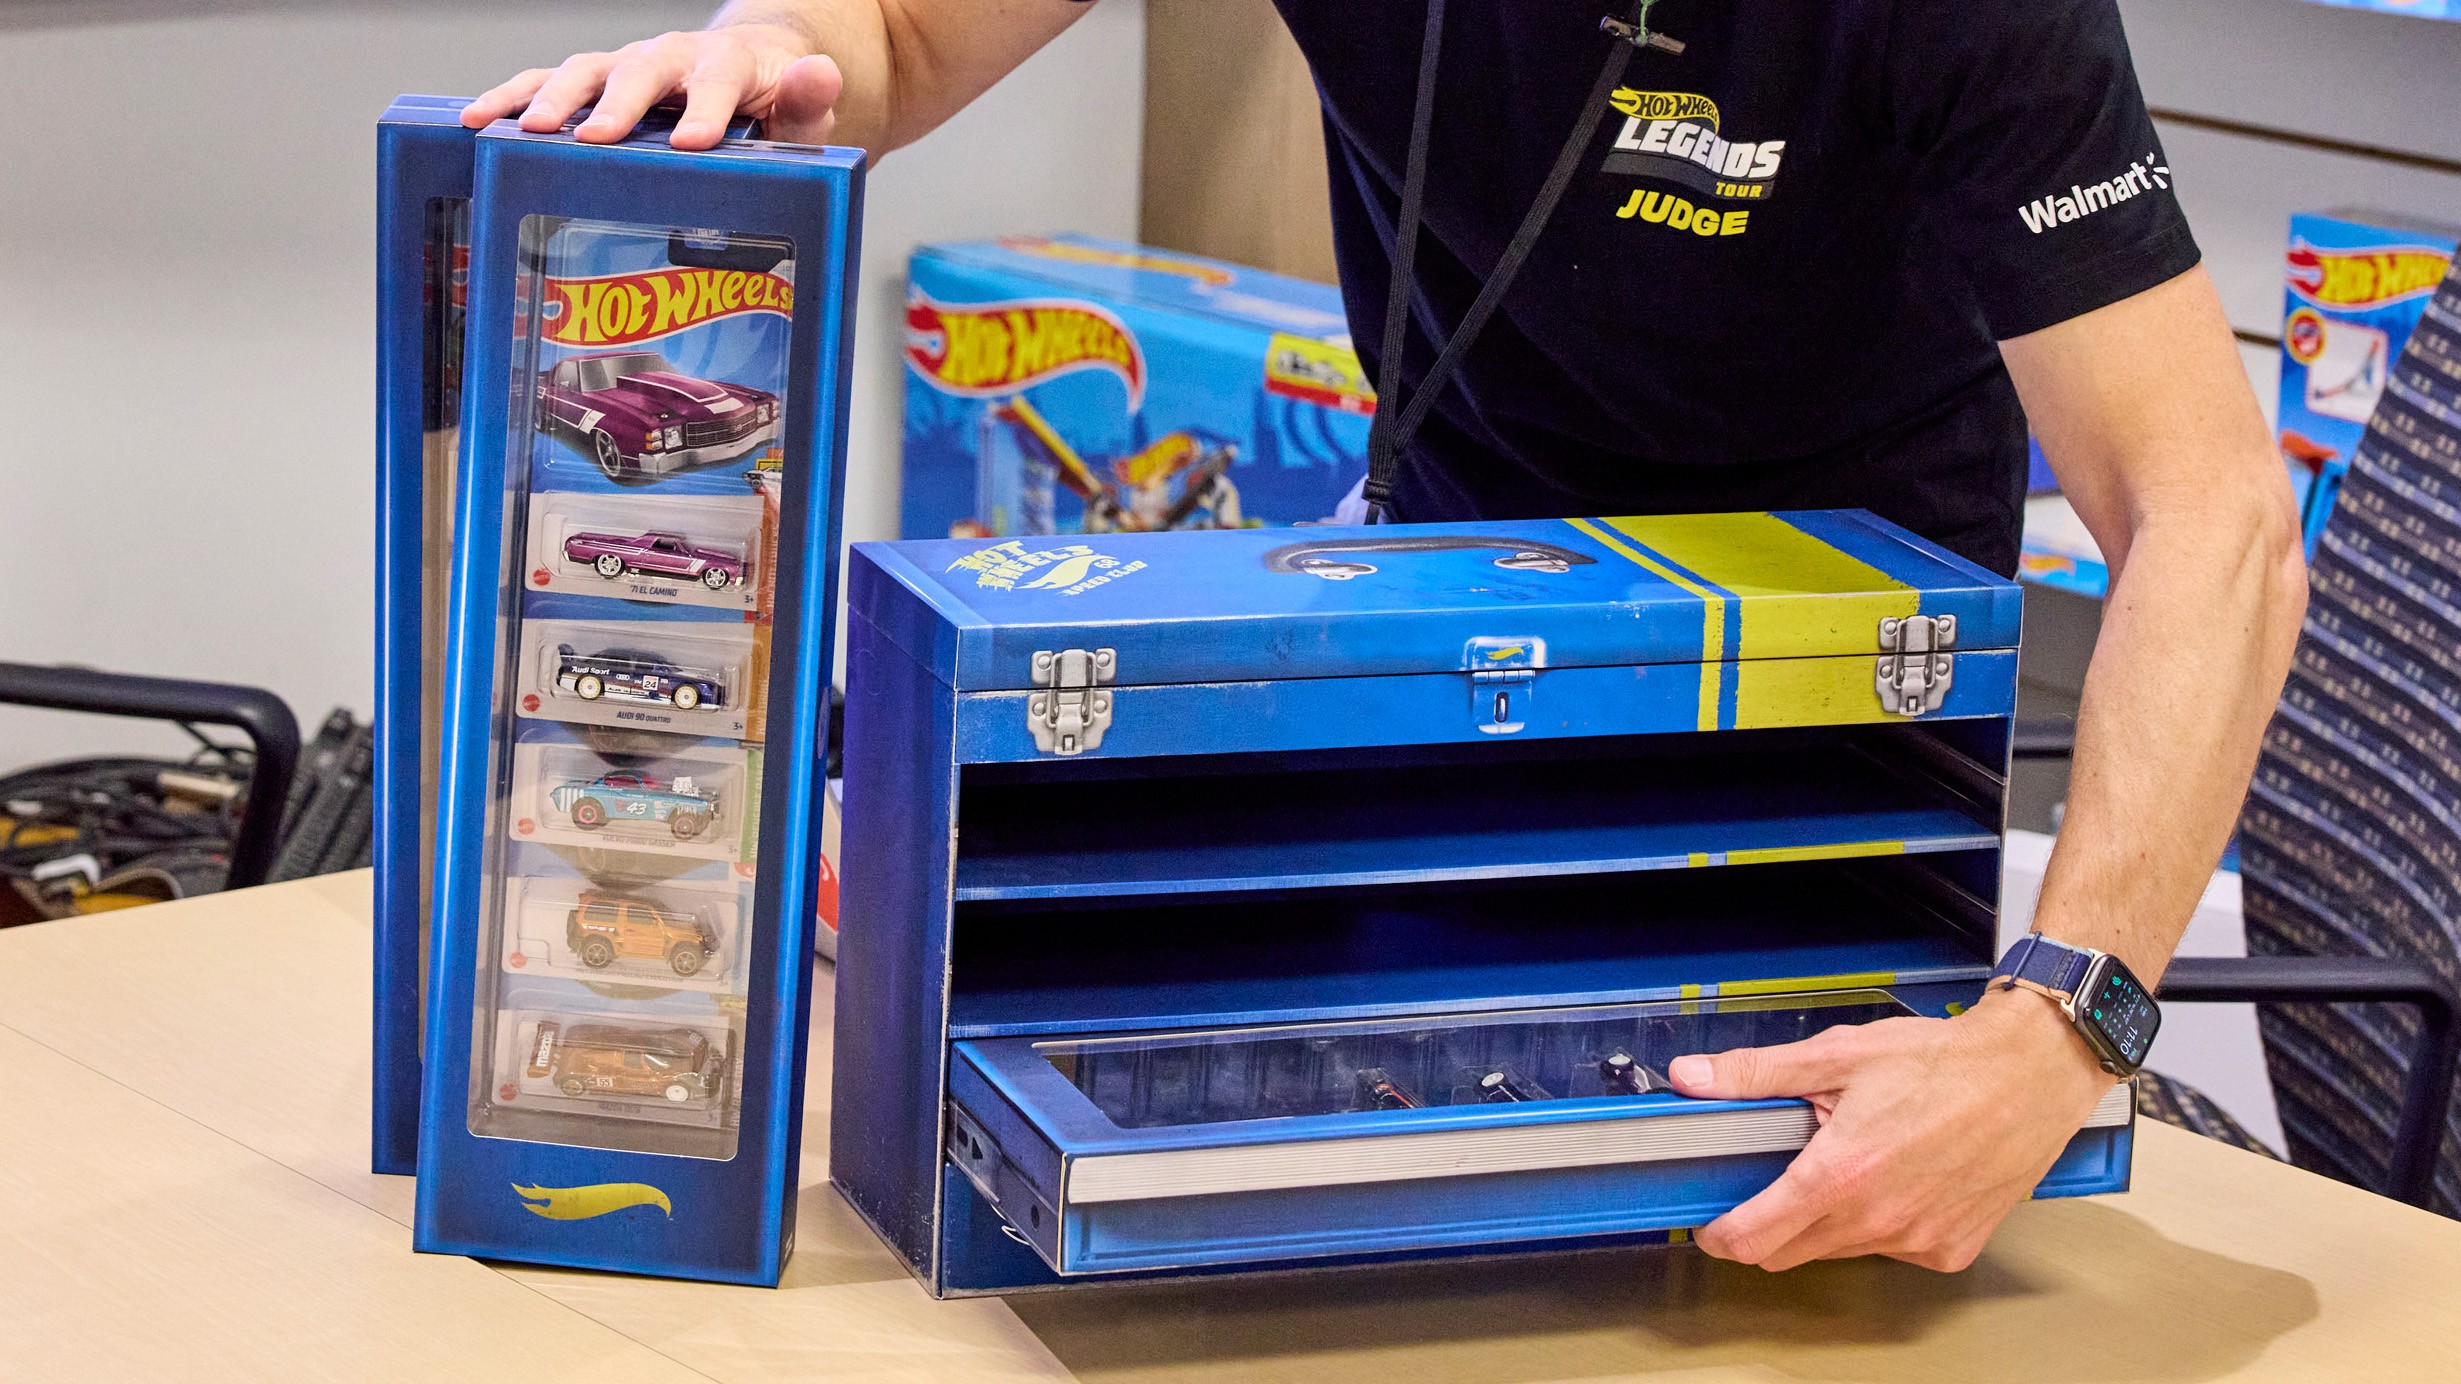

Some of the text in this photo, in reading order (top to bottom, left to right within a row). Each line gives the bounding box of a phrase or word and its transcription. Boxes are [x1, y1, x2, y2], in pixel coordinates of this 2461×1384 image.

[1613, 116, 1786, 178] LEGENDS
[1716, 181, 1763, 198] TOUR
[2018, 161, 2152, 234] Walmart
[1615, 189, 1750, 236] JUDGE
[571, 665, 589, 674] Audi
[644, 681, 657, 689] 24
[616, 711, 634, 720] AUDI
[635, 712, 645, 721] 90
[626, 802, 647, 815] 43
